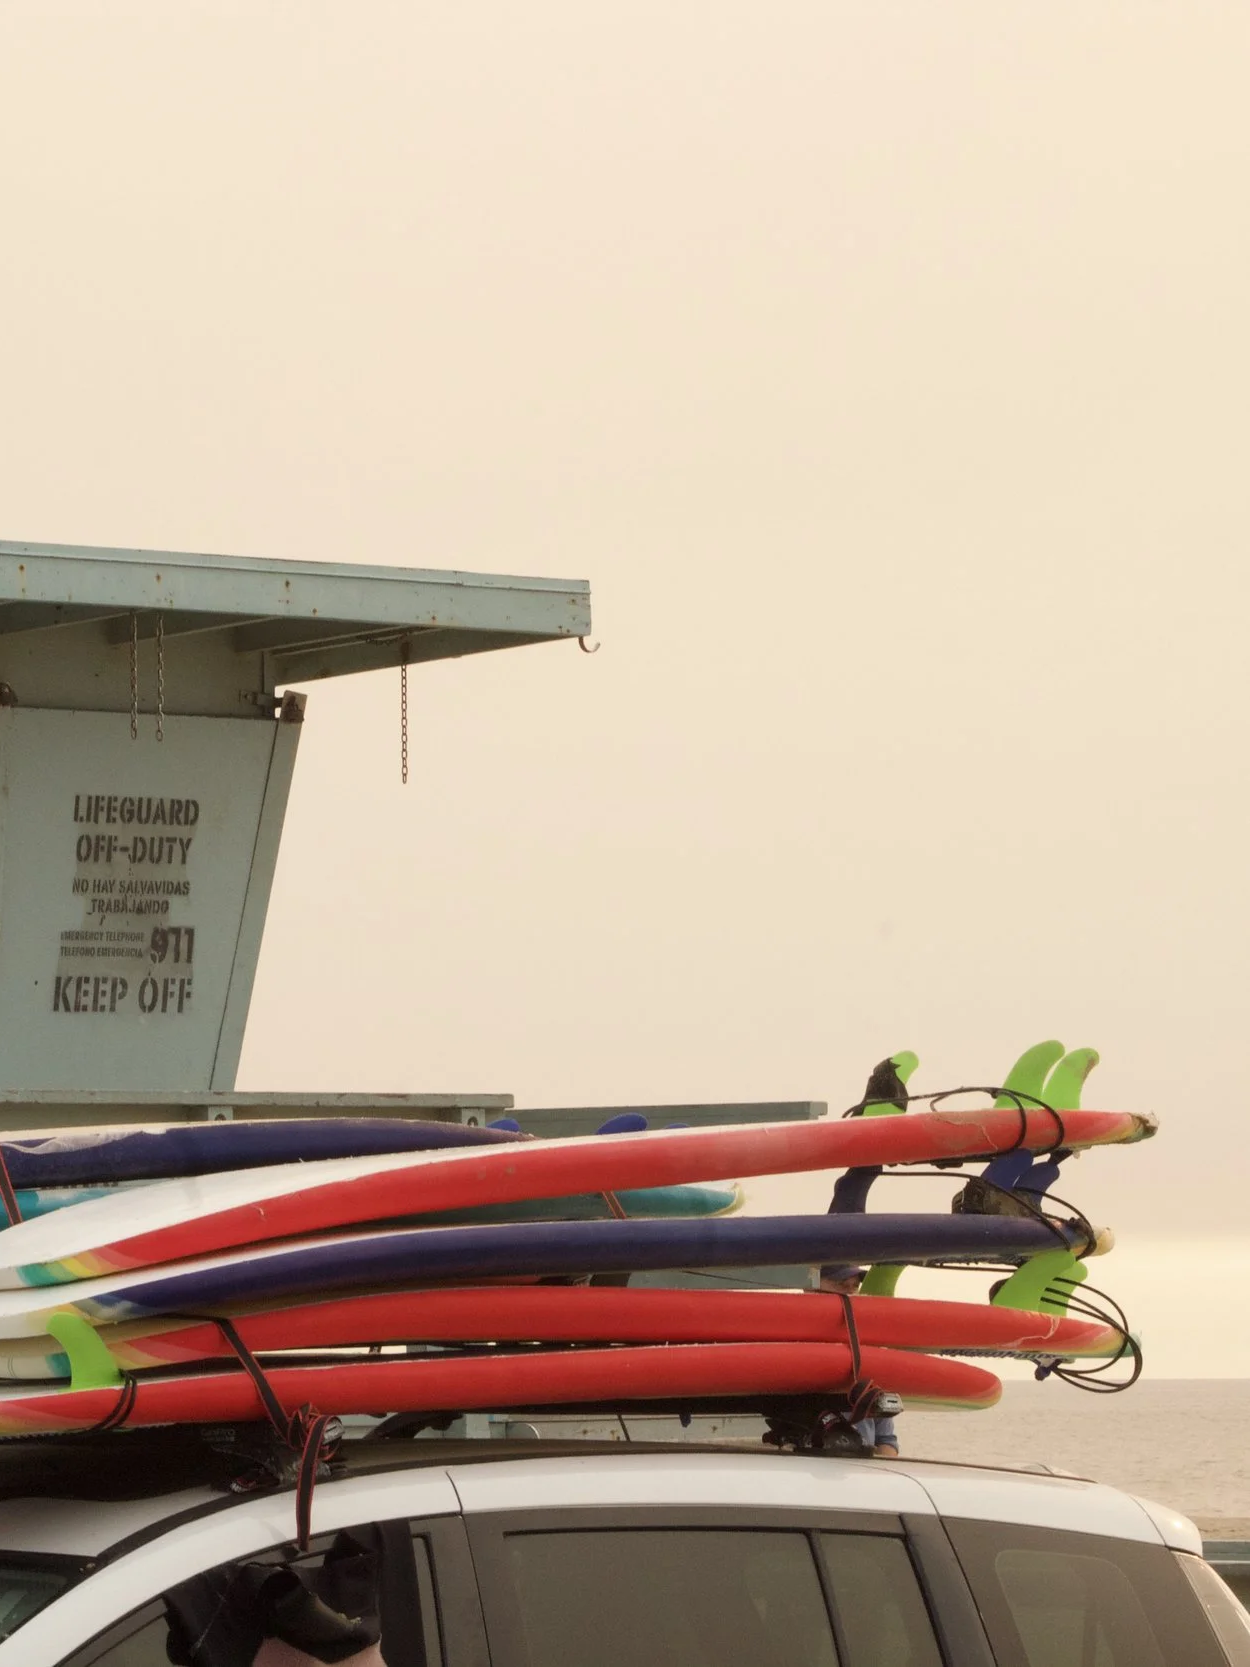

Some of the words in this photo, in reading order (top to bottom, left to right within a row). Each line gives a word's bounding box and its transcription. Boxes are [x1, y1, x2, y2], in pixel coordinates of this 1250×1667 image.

[73, 795, 200, 826] LIFEGUARD
[76, 834, 193, 864] OFF-DUTY
[72, 877, 89, 894] NO
[93, 878, 115, 895] HAY
[119, 880, 190, 896] SALVAVIDAS
[90, 899, 170, 915] TRABAJANDO
[151, 926, 195, 964] 911
[53, 976, 129, 1013] KEEP
[138, 977, 194, 1014] OFF
